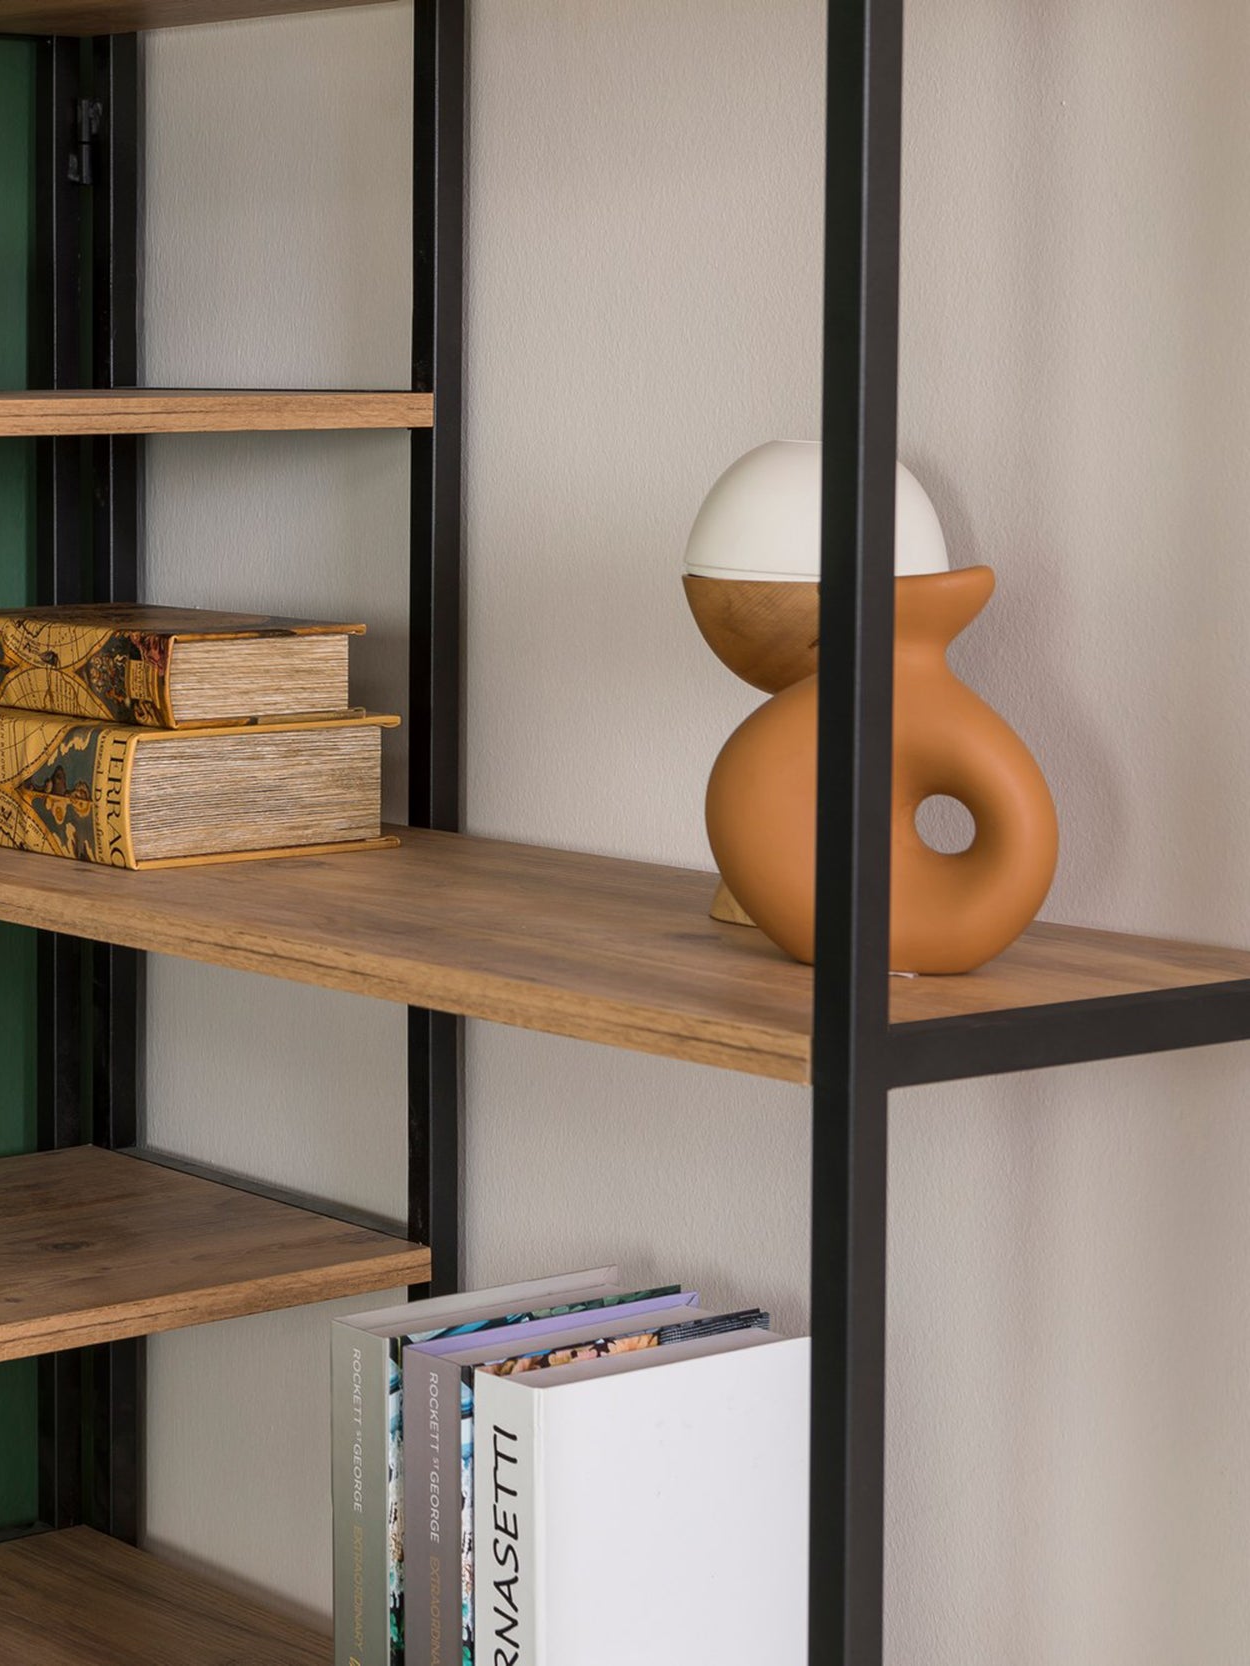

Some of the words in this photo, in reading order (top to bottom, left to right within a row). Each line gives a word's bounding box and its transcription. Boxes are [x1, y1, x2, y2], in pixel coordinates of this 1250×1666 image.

[352, 1347, 362, 1426] ROCKETT
[429, 1371, 440, 1453] ROCKETT
[353, 1444, 362, 1513] GEORGE
[430, 1471, 440, 1544] GEORGE
[353, 1526, 363, 1653] EXTRAORDINARY
